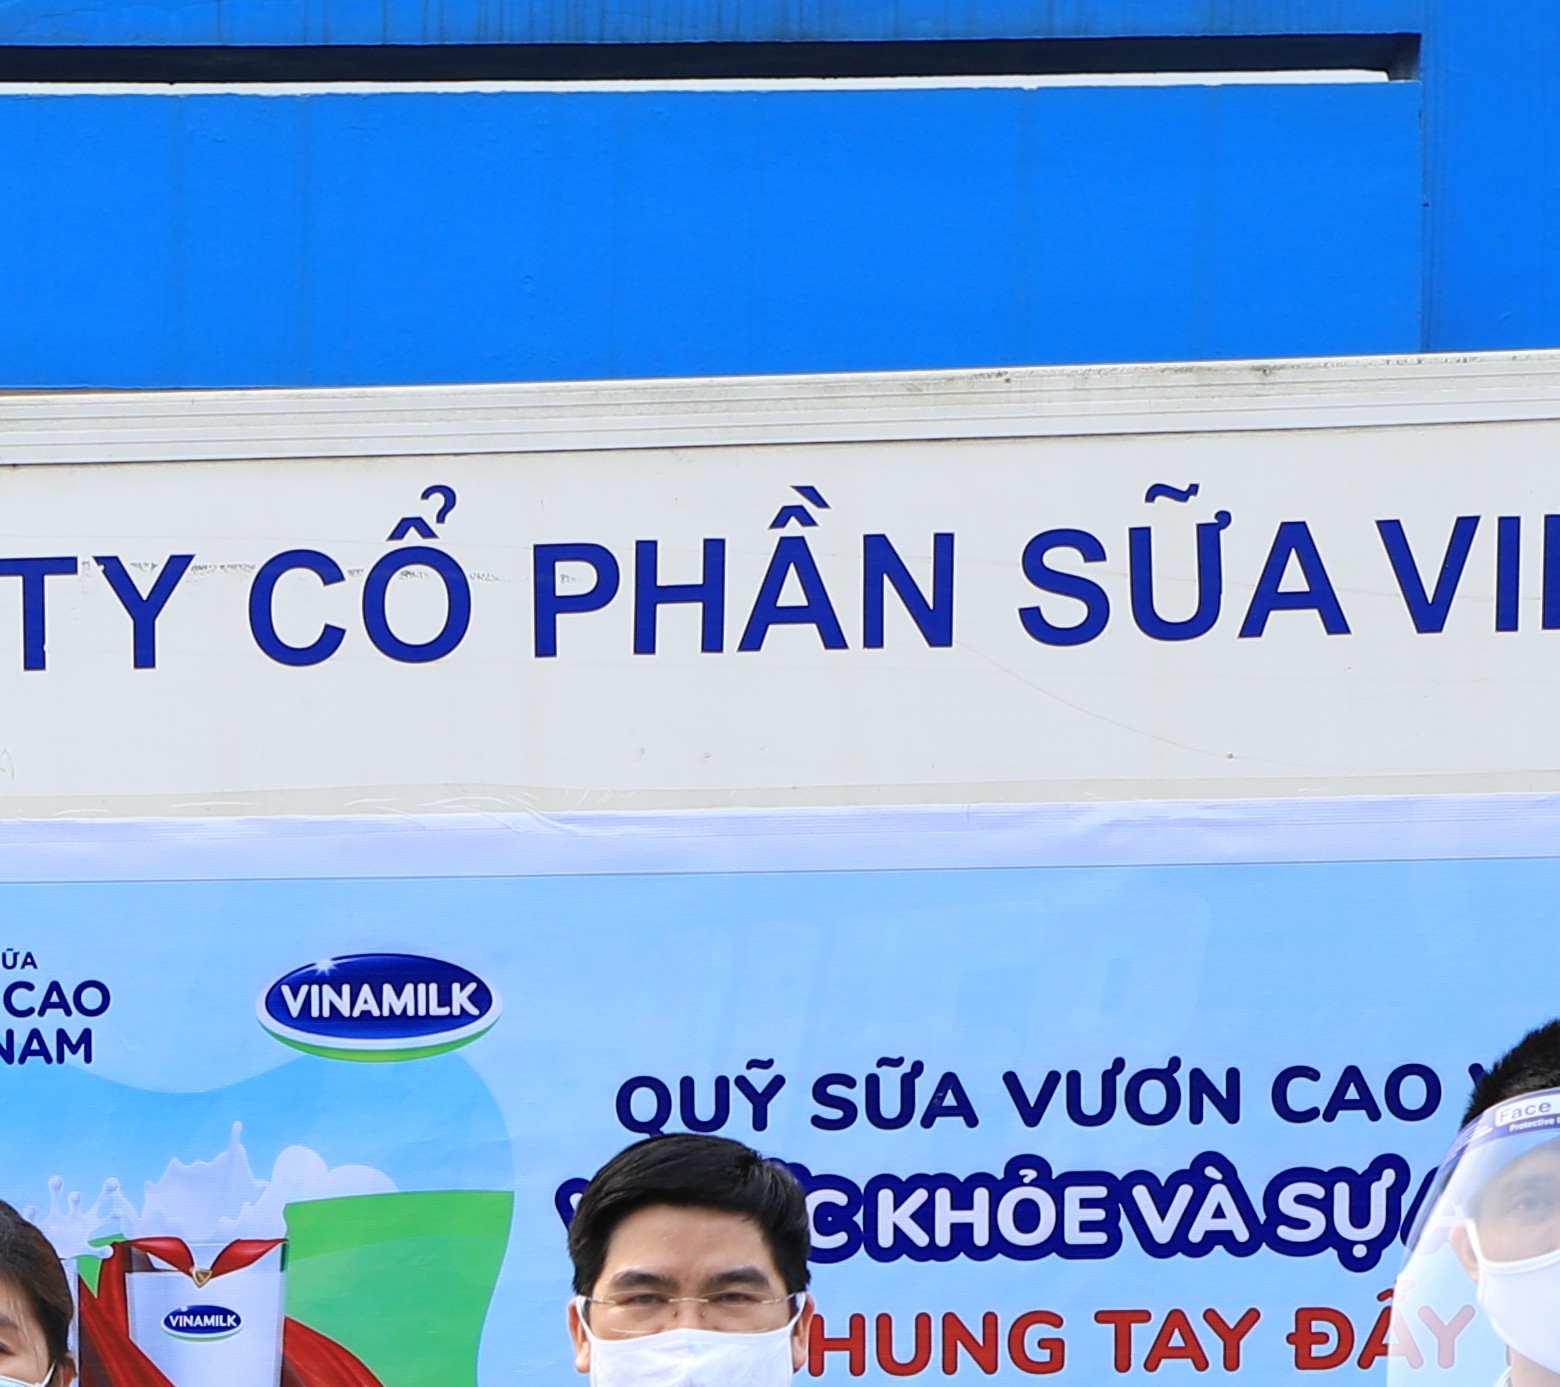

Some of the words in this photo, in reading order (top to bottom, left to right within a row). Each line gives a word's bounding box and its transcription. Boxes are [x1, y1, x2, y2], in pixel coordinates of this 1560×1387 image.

[250, 485, 471, 665] CỔ
[535, 486, 954, 656] PHẦN
[1021, 484, 1350, 645] SỮA
[3, 980, 110, 1018] CAO
[282, 983, 479, 1017] VINAMILK
[615, 1057, 786, 1138] QUỸ
[811, 1056, 979, 1131] SỮA
[1003, 1056, 1240, 1127] VƯƠN
[1272, 1064, 1441, 1123] CAO
[1499, 1100, 1551, 1124] Face
[1508, 1116, 1556, 1133] Protective
[879, 1170, 1107, 1247] KHỎE
[1133, 1167, 1248, 1243] VÀ
[1278, 1169, 1395, 1257] SỰ
[167, 1311, 239, 1329] VINAMILK
[808, 1309, 1066, 1377] HUNG
[1096, 1310, 1259, 1371] TAY
[1286, 1276, 1477, 1371] ĐẨY
